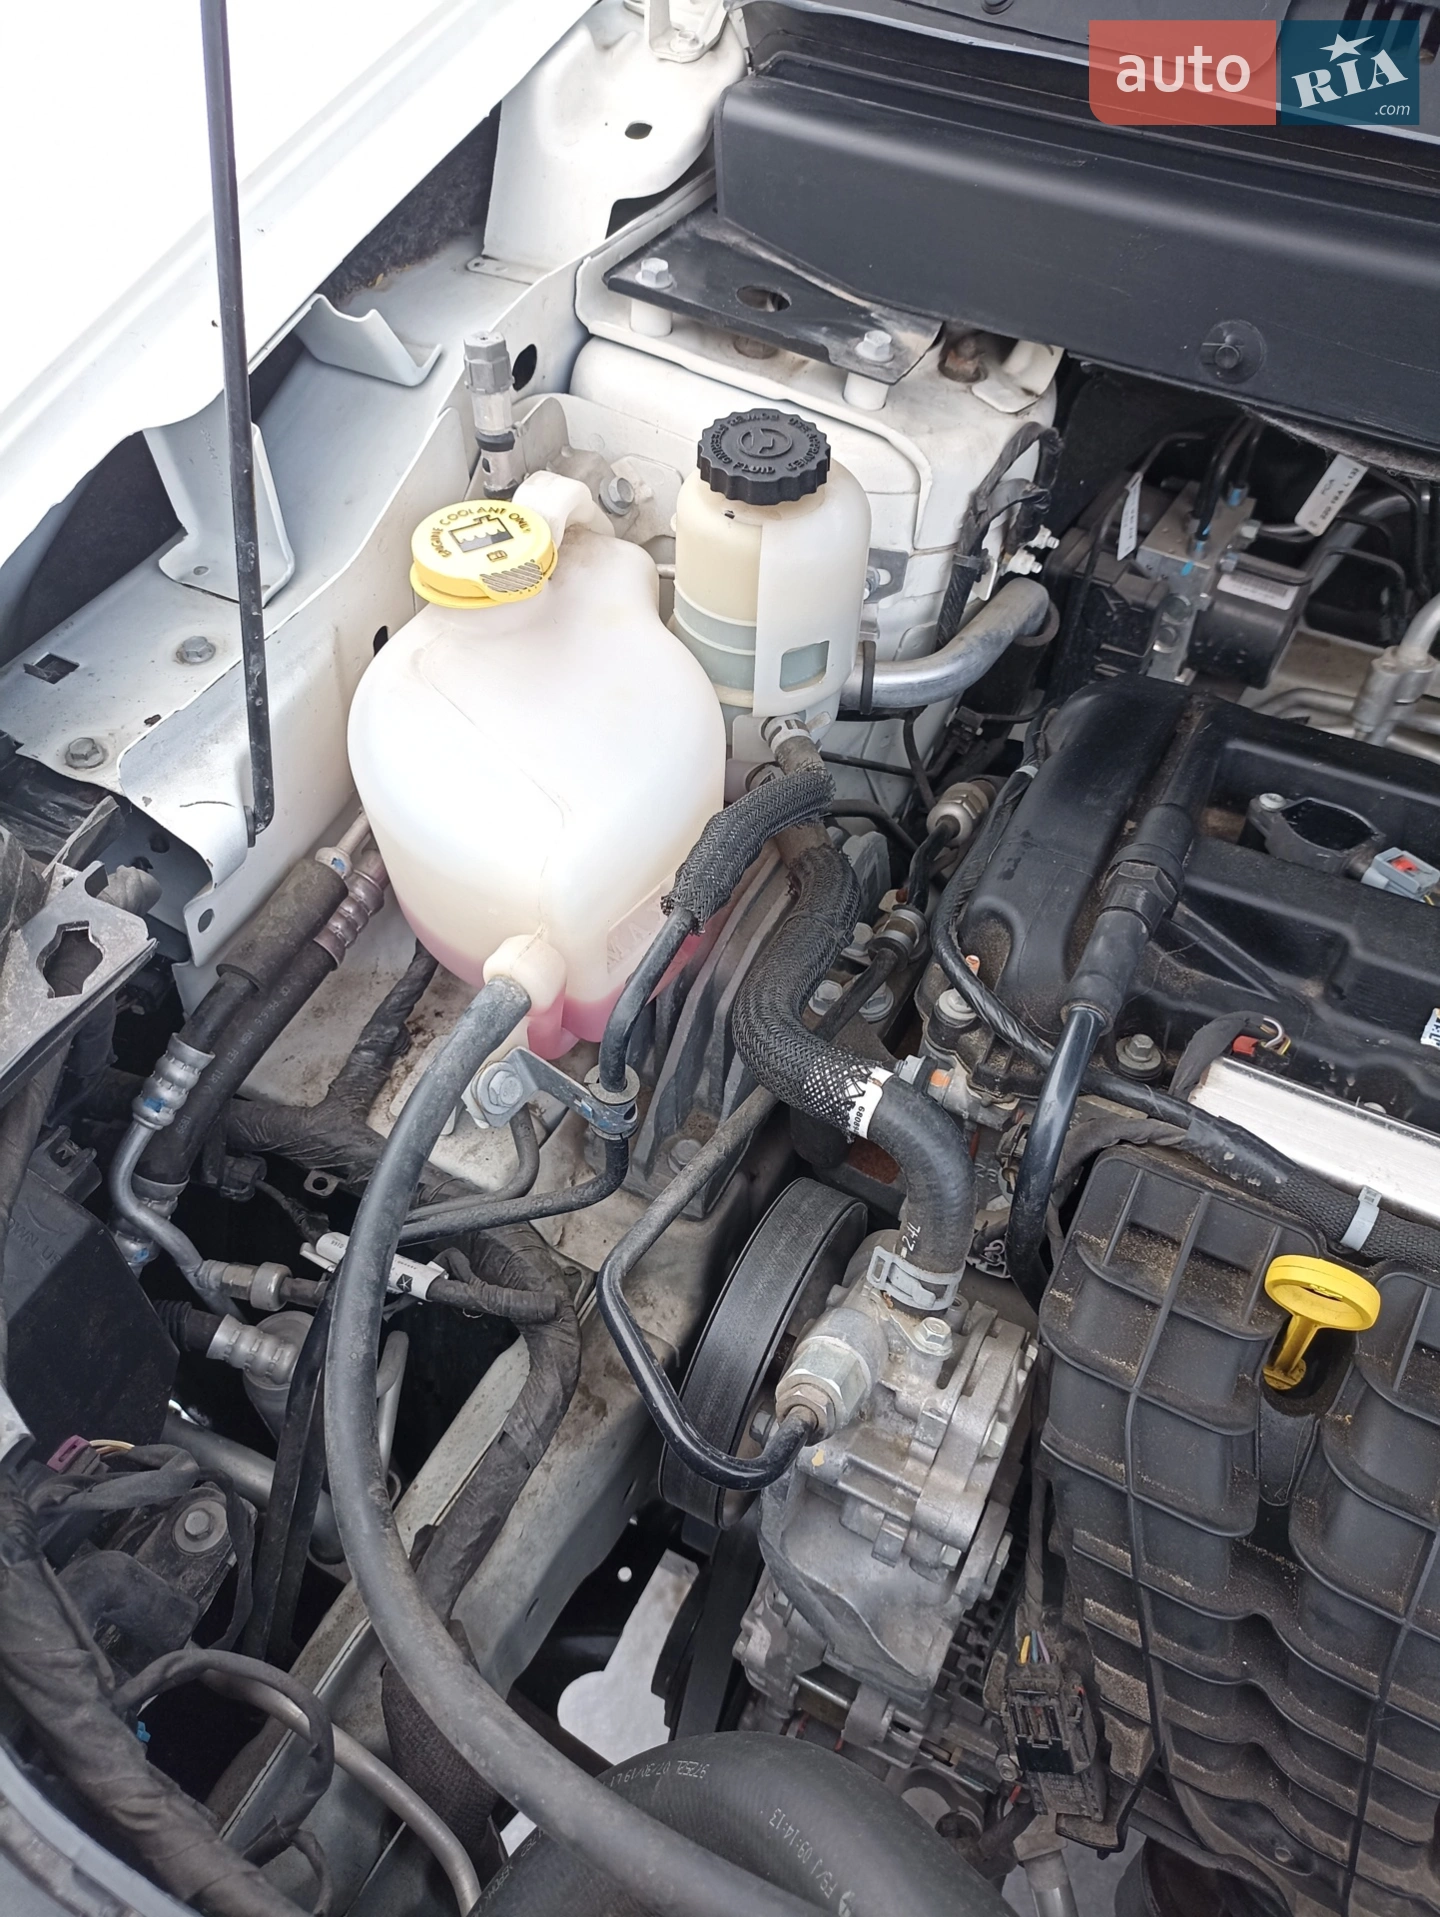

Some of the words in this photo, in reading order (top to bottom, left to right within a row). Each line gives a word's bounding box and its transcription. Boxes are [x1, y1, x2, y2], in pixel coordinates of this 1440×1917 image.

[709, 424, 733, 465] STEERING
[733, 461, 776, 475] FLUID
[439, 506, 507, 527] COOLANT
[508, 512, 532, 534] ONLY
[430, 526, 453, 558] ENGINE
[901, 1221, 921, 1252] 2.4L
